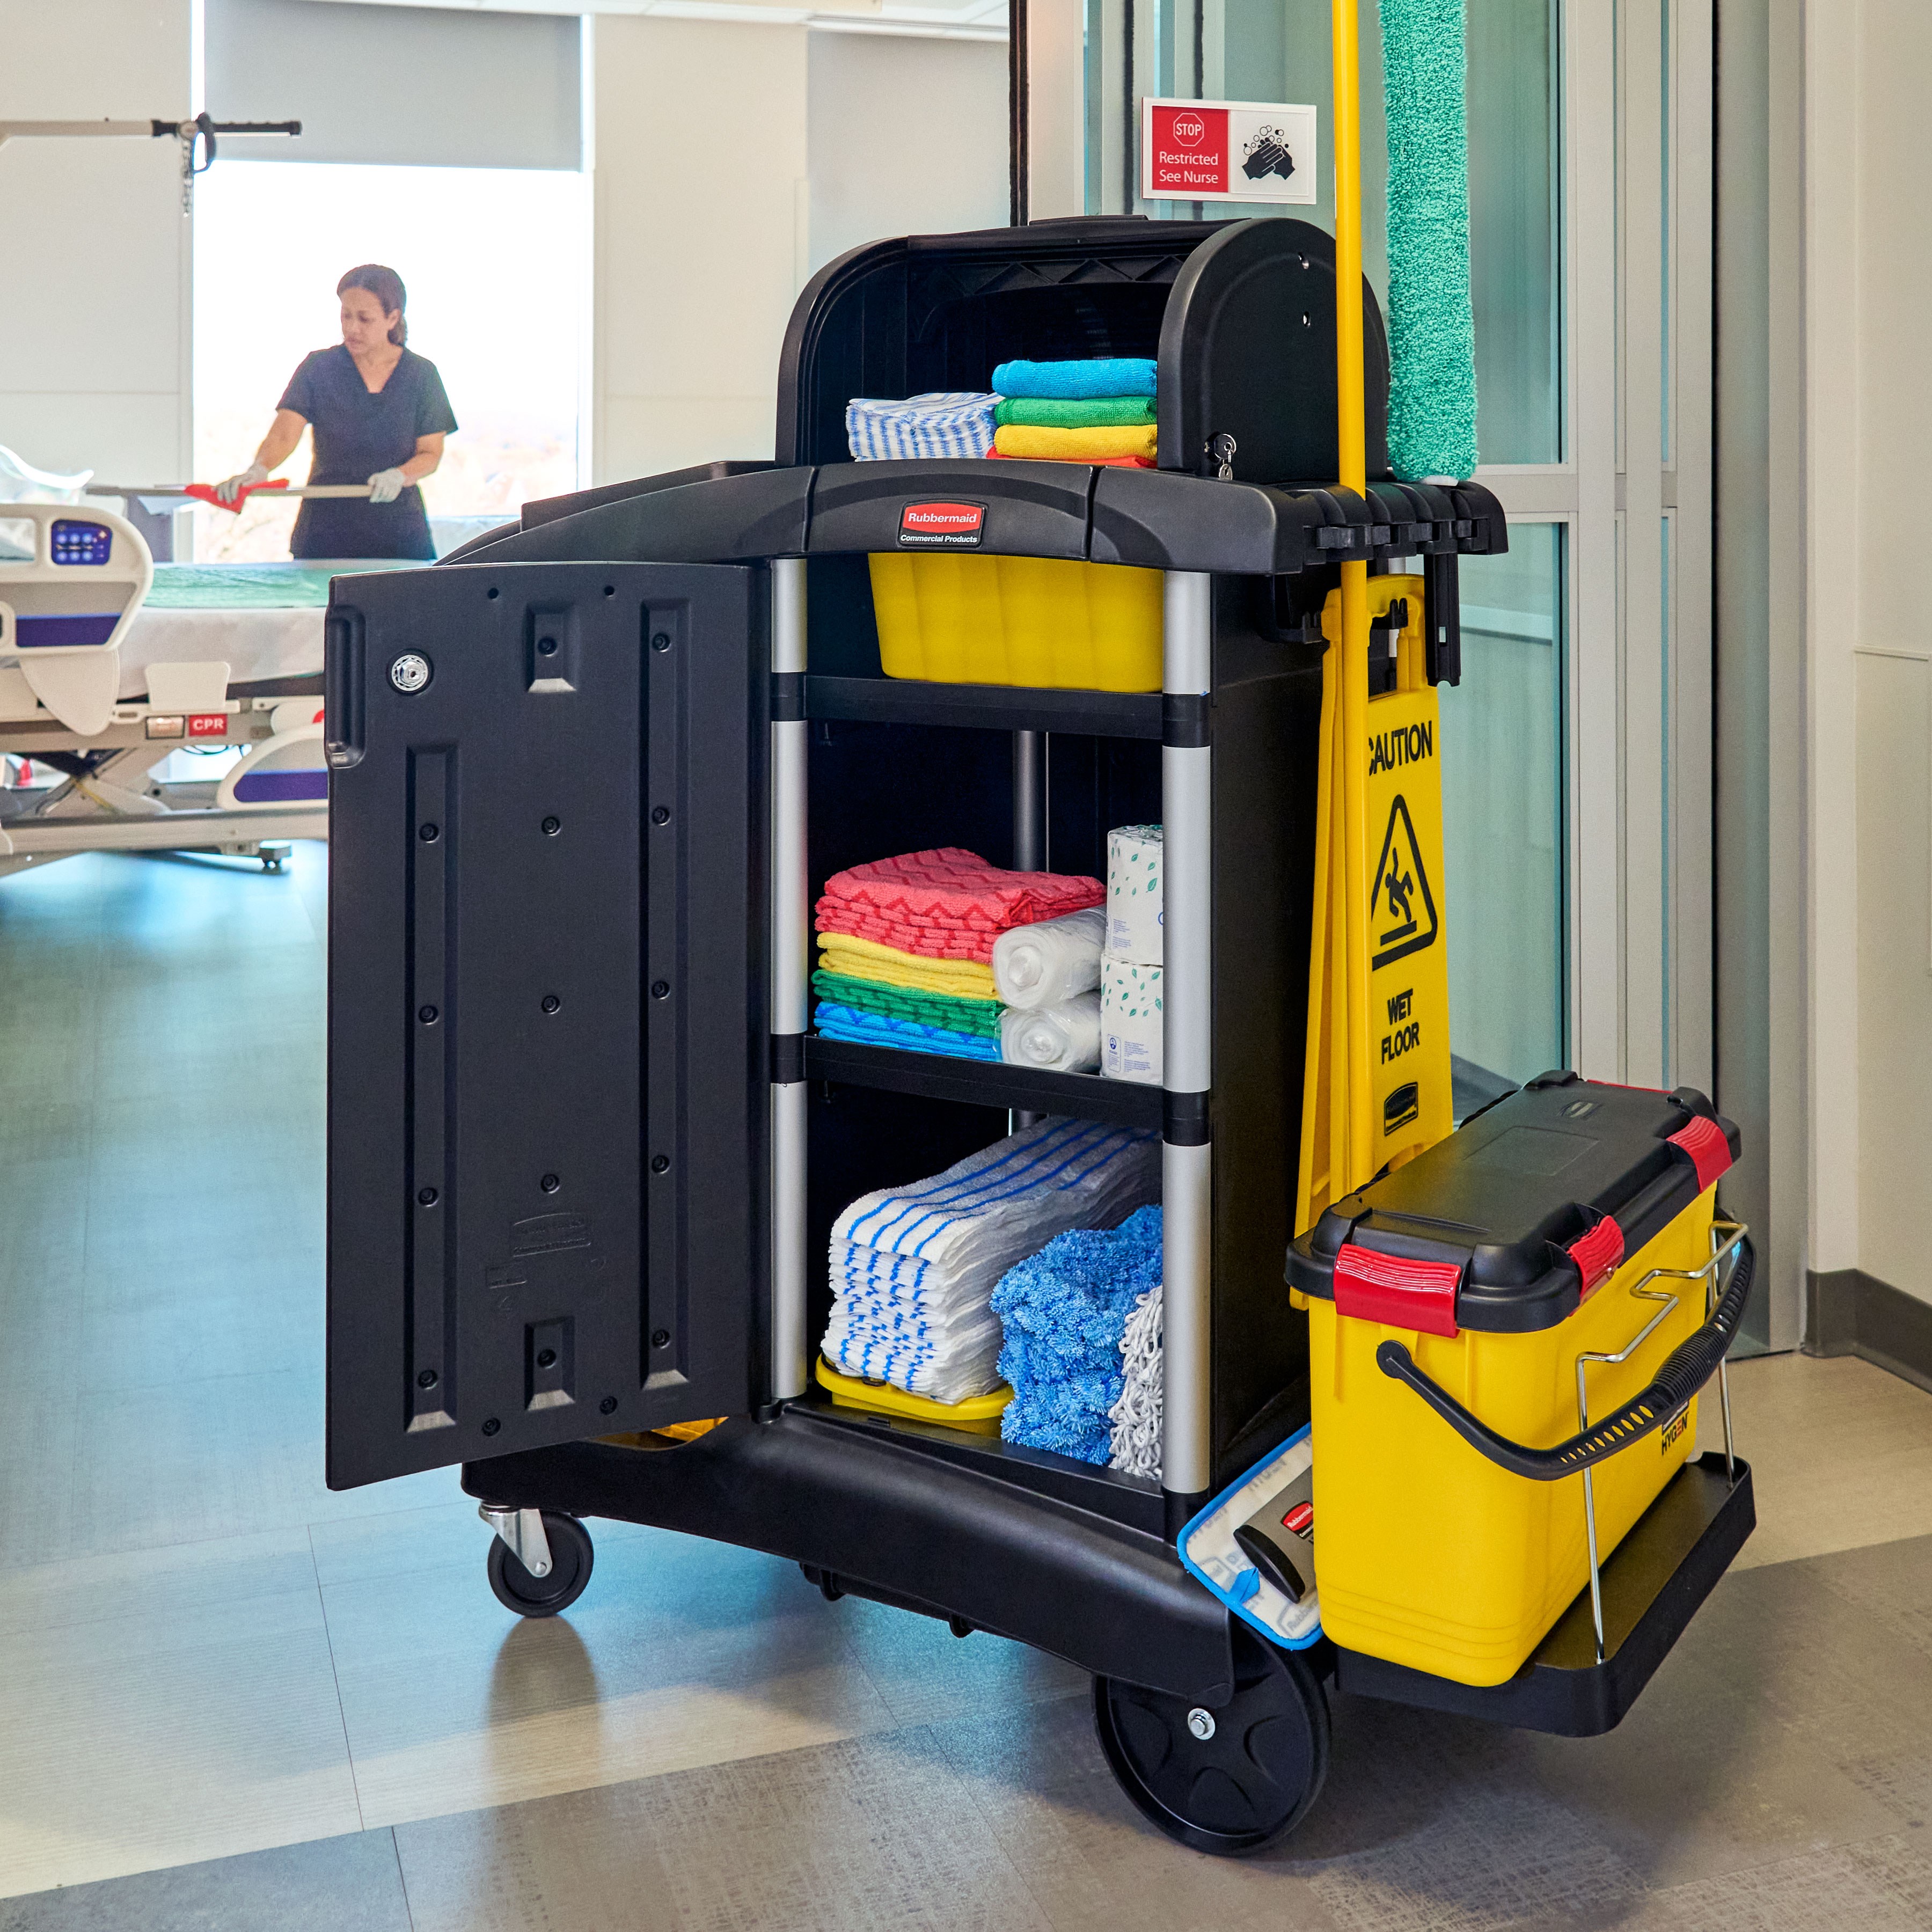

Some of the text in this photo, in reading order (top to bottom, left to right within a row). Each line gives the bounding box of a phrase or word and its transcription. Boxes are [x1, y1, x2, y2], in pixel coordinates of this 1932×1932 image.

[1176, 123, 1202, 136] STOP
[1159, 151, 1218, 165] Restricted
[1159, 170, 1218, 184] See Nurse
[908, 513, 977, 523] Rubbermaid
[193, 718, 224, 731] CPR
[1387, 988, 1413, 1026] WET
[1381, 1022, 1419, 1065] FLOOR
[1662, 1414, 1689, 1455] HYGEN
[1287, 1506, 1313, 1528] Rubbermaid
